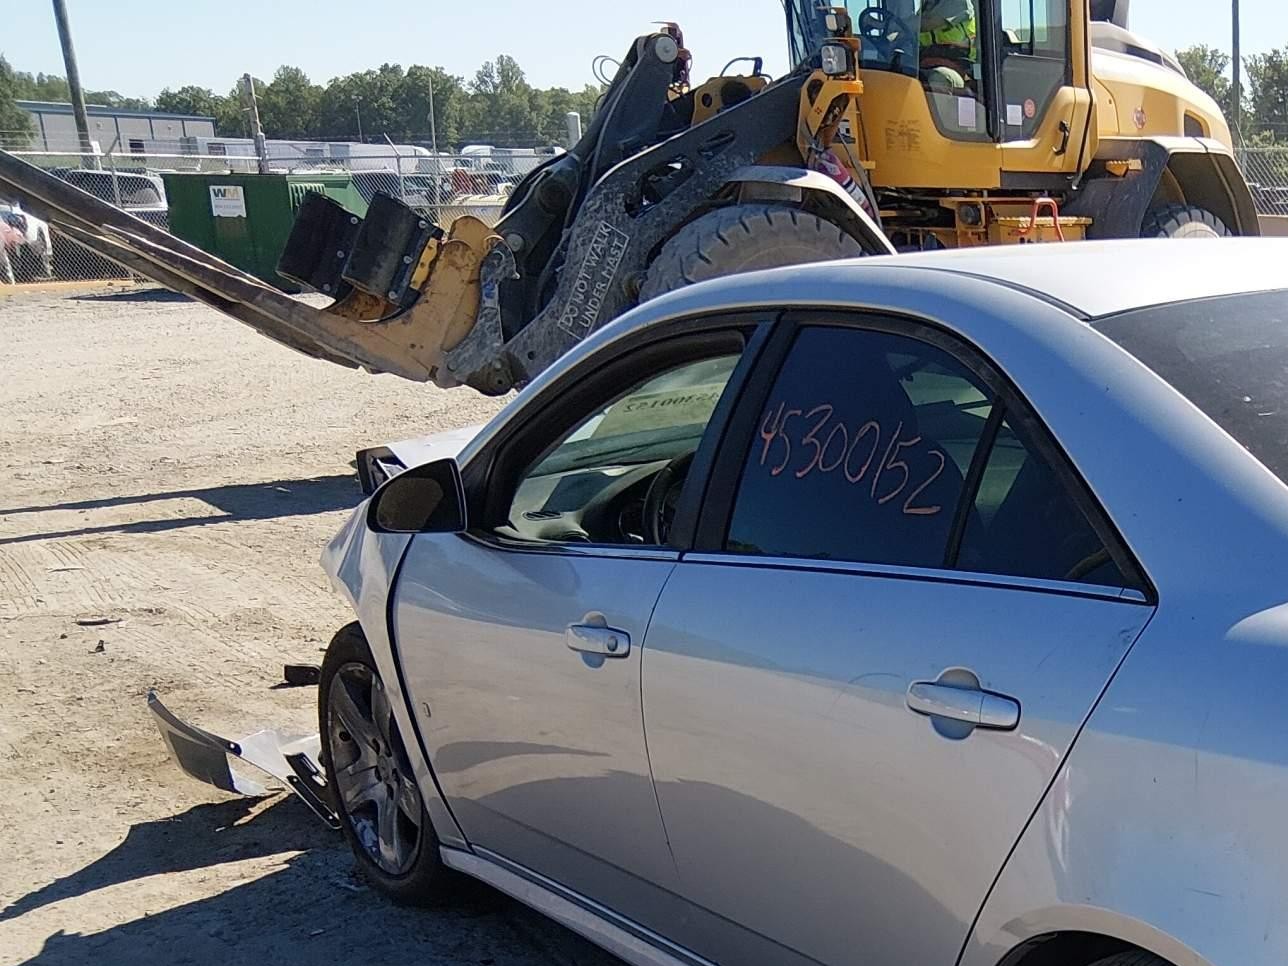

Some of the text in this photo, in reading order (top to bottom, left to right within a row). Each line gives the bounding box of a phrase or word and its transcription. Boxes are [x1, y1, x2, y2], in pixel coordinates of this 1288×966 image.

[562, 223, 612, 327] DO NOT WALK
[579, 238, 625, 328] UNDER MAST
[761, 401, 945, 514] 45300152
